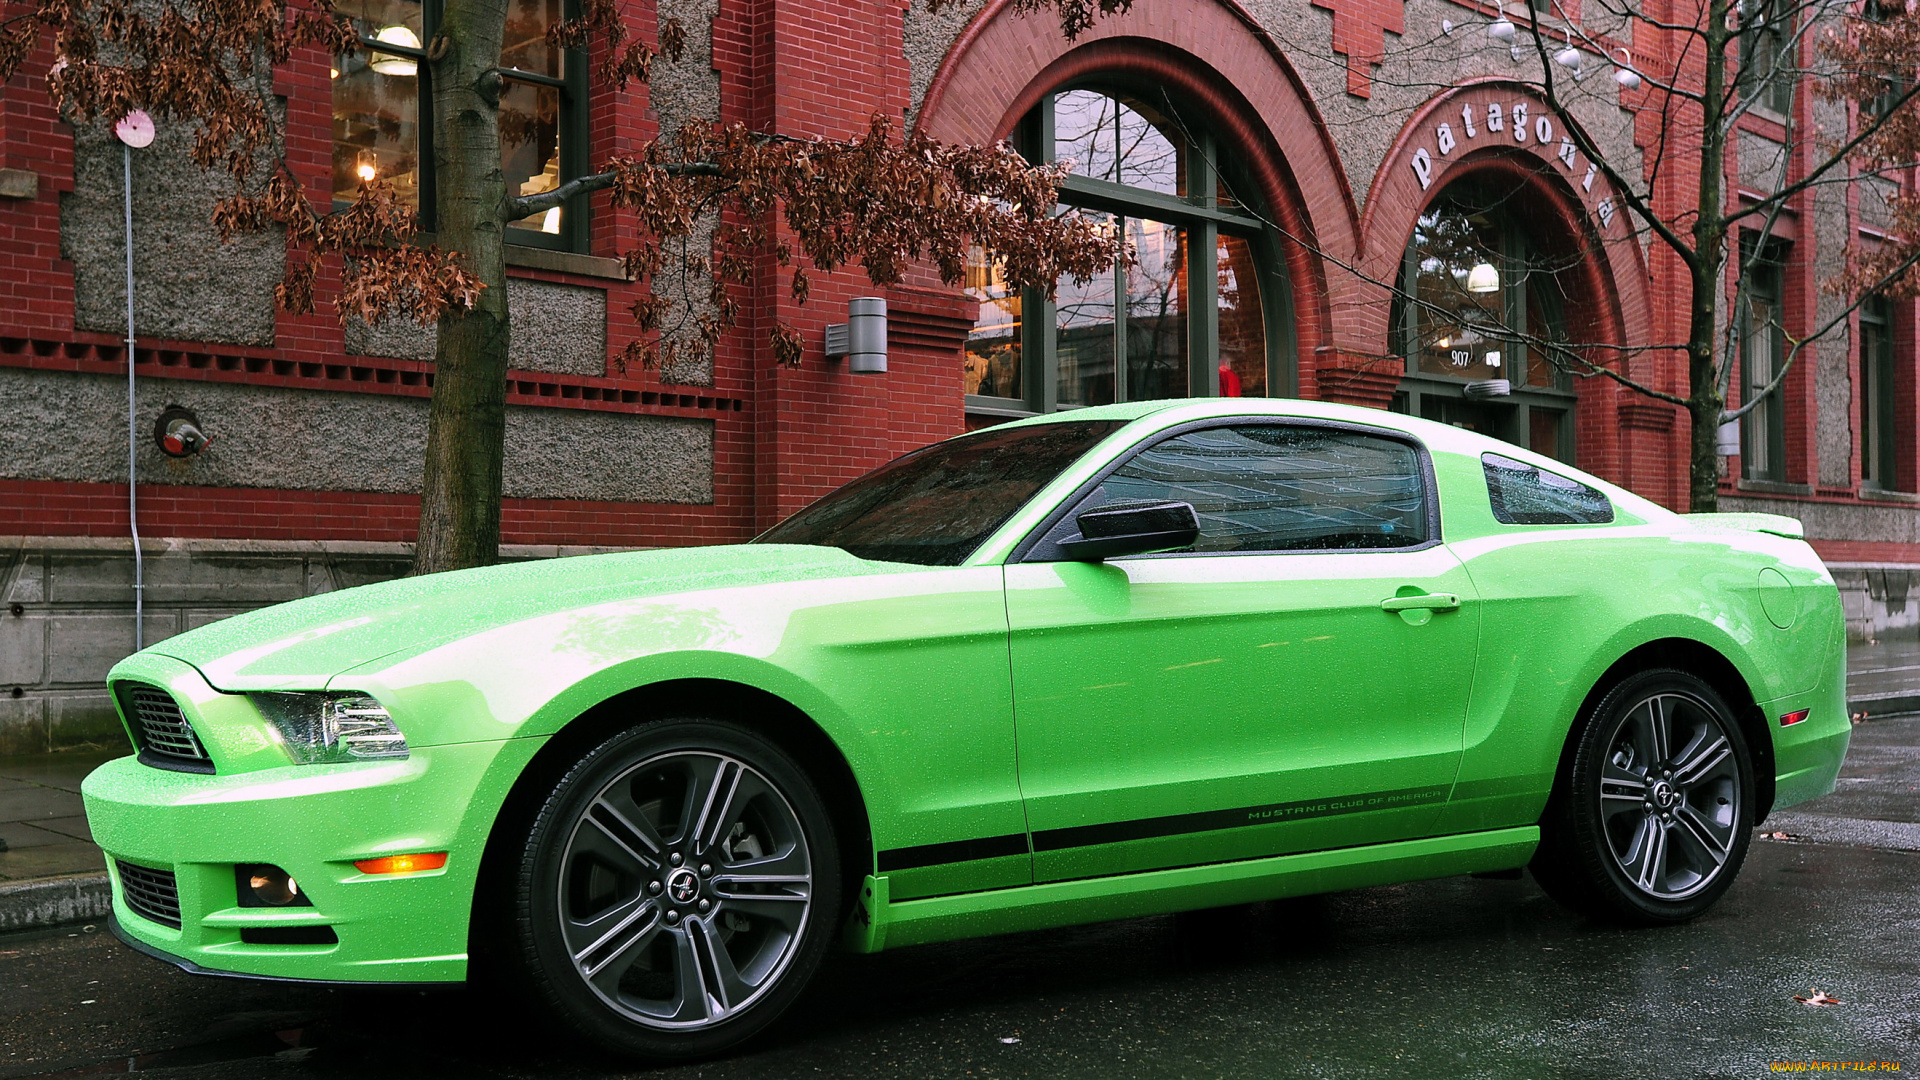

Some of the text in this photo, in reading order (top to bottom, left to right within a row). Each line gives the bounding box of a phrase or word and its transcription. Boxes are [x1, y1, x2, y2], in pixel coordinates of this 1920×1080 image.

[1411, 103, 1614, 228] patagonia
[1451, 350, 1469, 367] 907
[1248, 804, 1327, 819] MUSTANG
[1387, 791, 1441, 802] AMERICA
